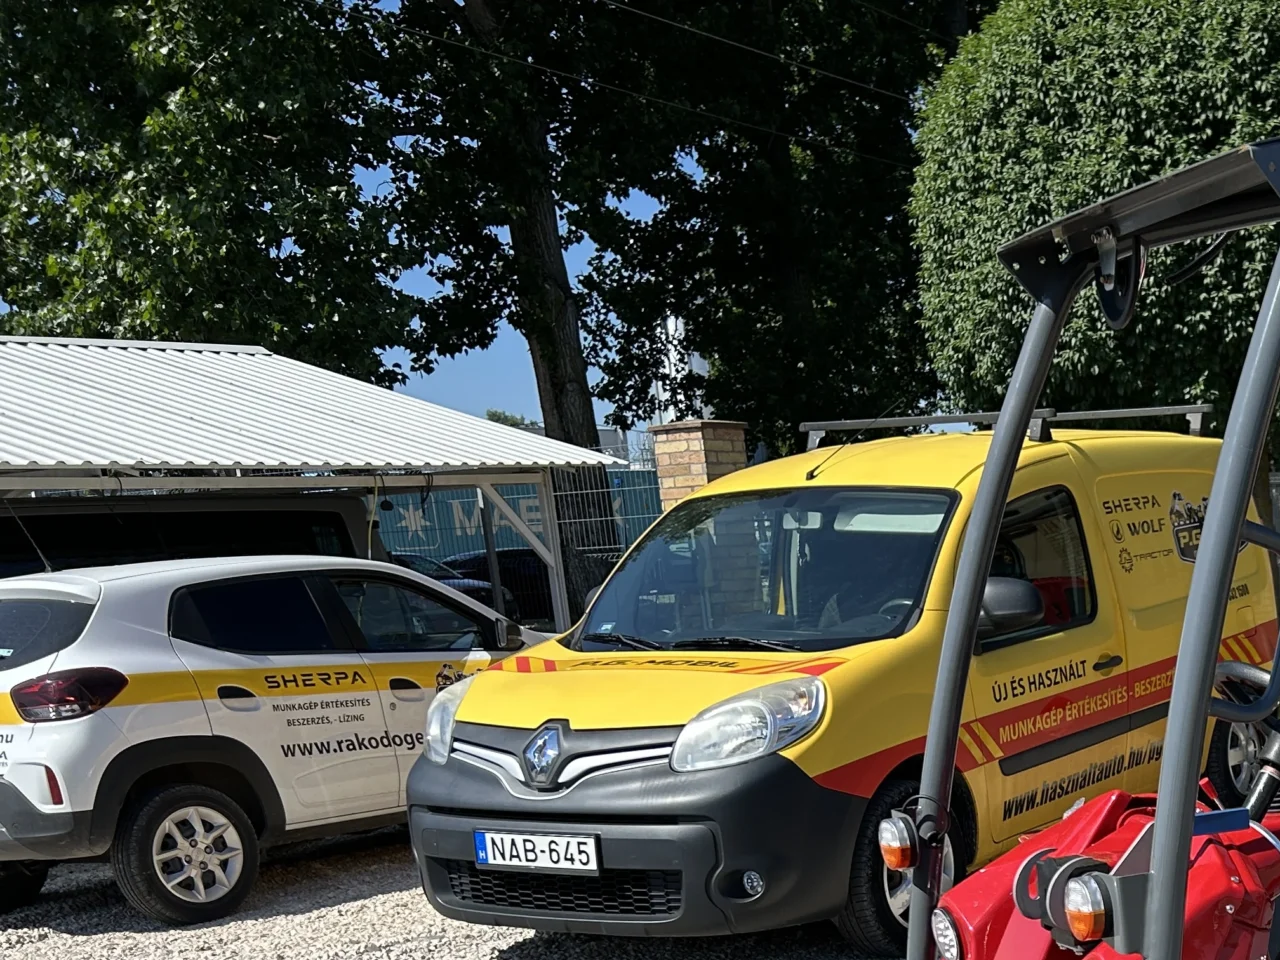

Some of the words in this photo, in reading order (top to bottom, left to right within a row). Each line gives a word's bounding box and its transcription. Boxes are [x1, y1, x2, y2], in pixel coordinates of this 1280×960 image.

[1102, 495, 1161, 515] SHERPA
[1127, 518, 1166, 537] WOLF
[264, 670, 367, 690] SHERPA
[991, 681, 1009, 703] ÚJ
[1011, 675, 1026, 699] ÉS
[1027, 659, 1088, 694] HASZNÁLT
[272, 701, 319, 713] MUNKAGÉP
[320, 698, 371, 710] ÉRTÉKESÍTÉS
[999, 708, 1063, 745] MUNKAGÉP
[1065, 686, 1129, 722] ÉRTÉKESÍTÉS
[1134, 669, 1176, 699] BESZERZ
[338, 713, 365, 724] LÍZING
[490, 836, 591, 866] NAB-645
